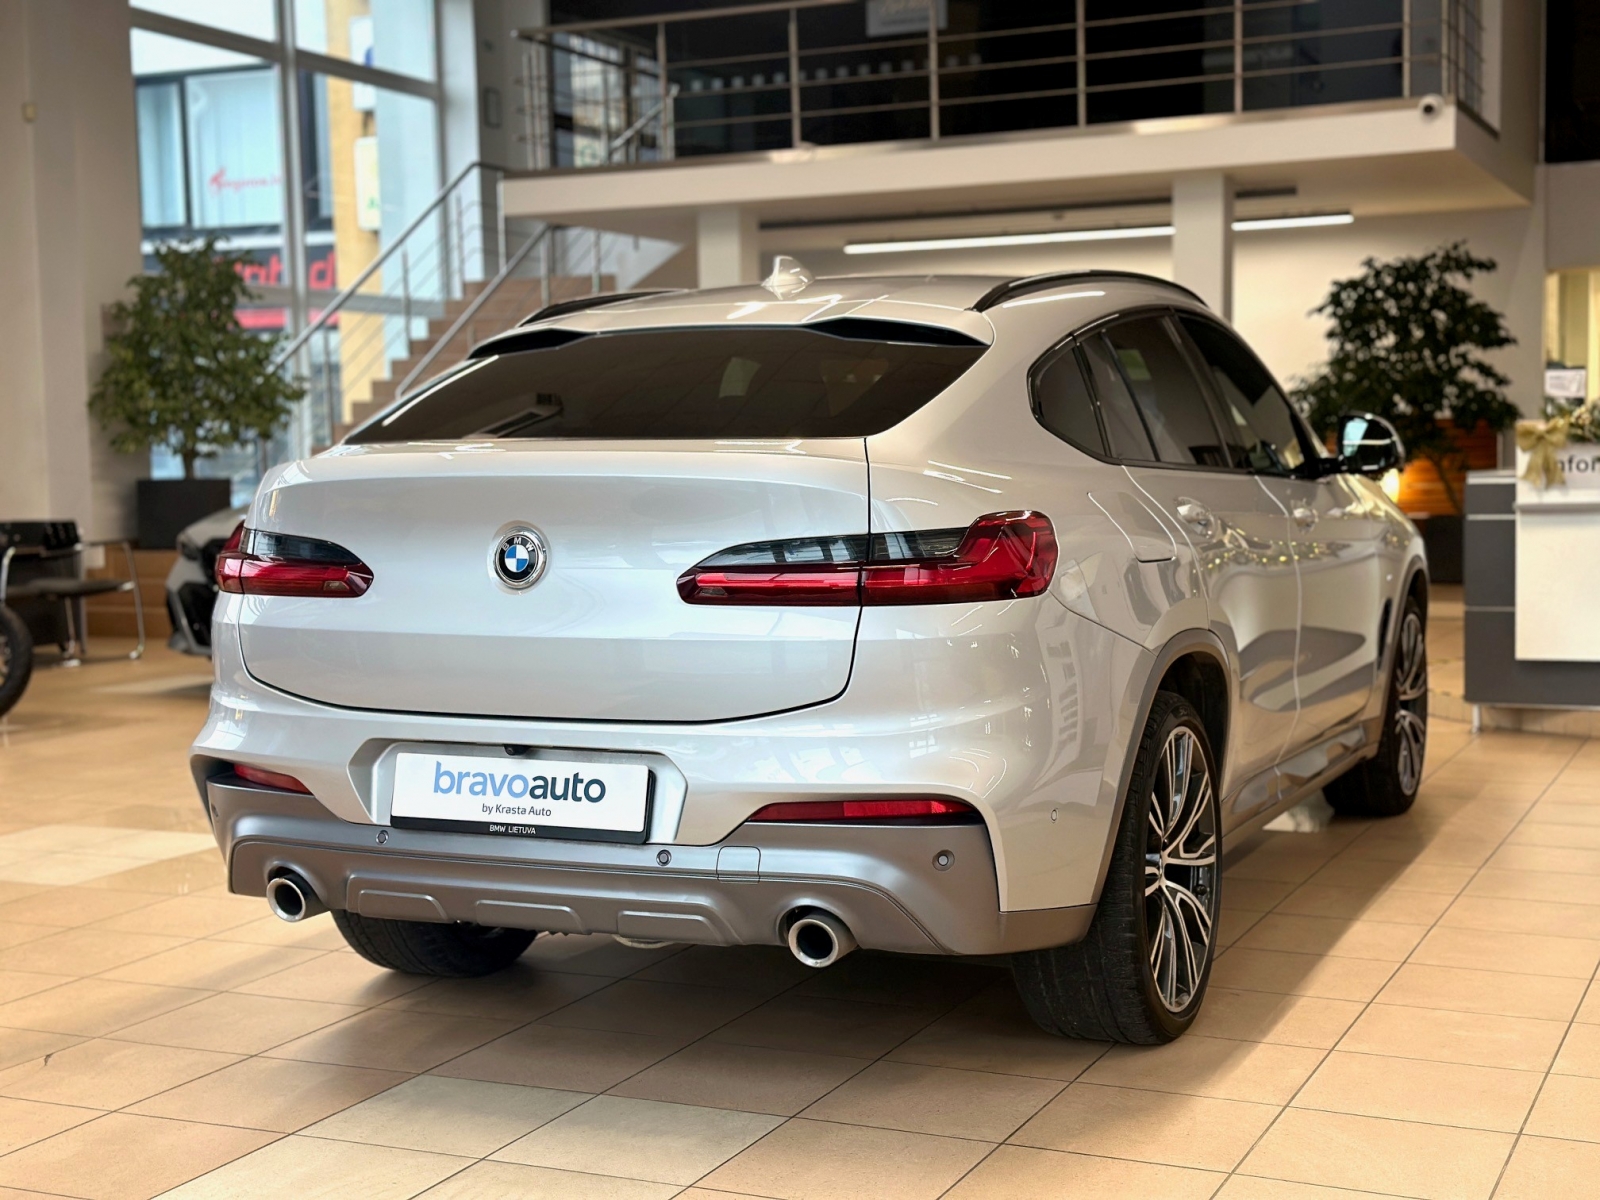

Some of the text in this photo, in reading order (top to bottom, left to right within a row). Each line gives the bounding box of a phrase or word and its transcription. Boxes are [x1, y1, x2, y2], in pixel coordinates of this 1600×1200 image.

[501, 537, 534, 551] BMW
[433, 760, 606, 803] bravoauto
[482, 803, 552, 817] by Krasta Auto
[489, 824, 536, 835] BMW LIETUVA
